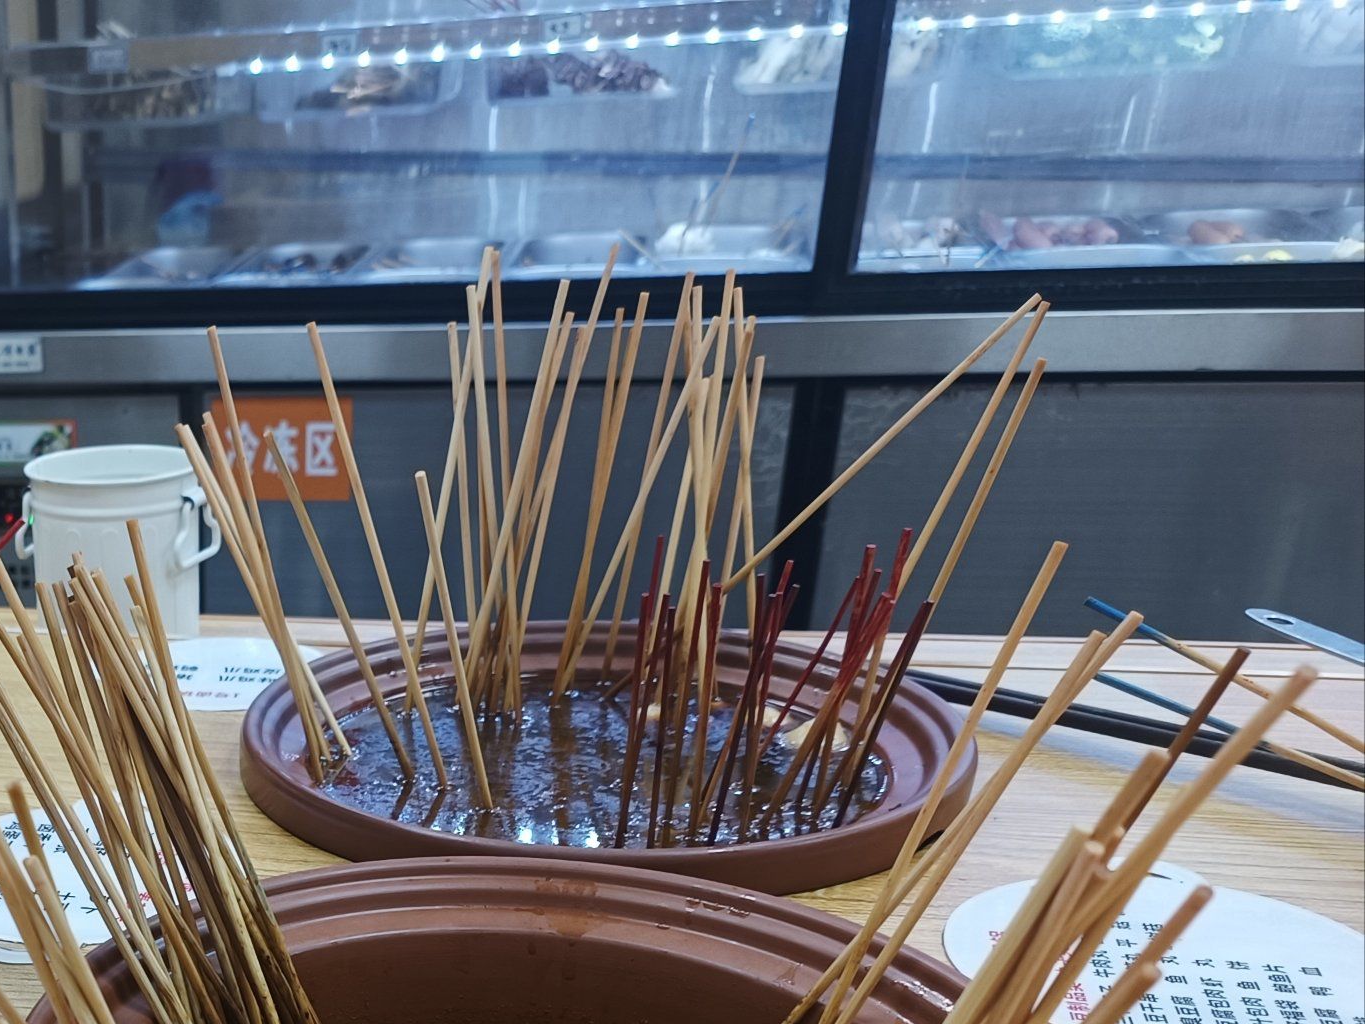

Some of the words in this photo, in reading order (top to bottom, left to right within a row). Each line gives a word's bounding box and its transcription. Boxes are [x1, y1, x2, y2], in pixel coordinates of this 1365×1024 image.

[225, 420, 339, 477] 冷冻区
[1261, 963, 1297, 994] 鲍鱼片
